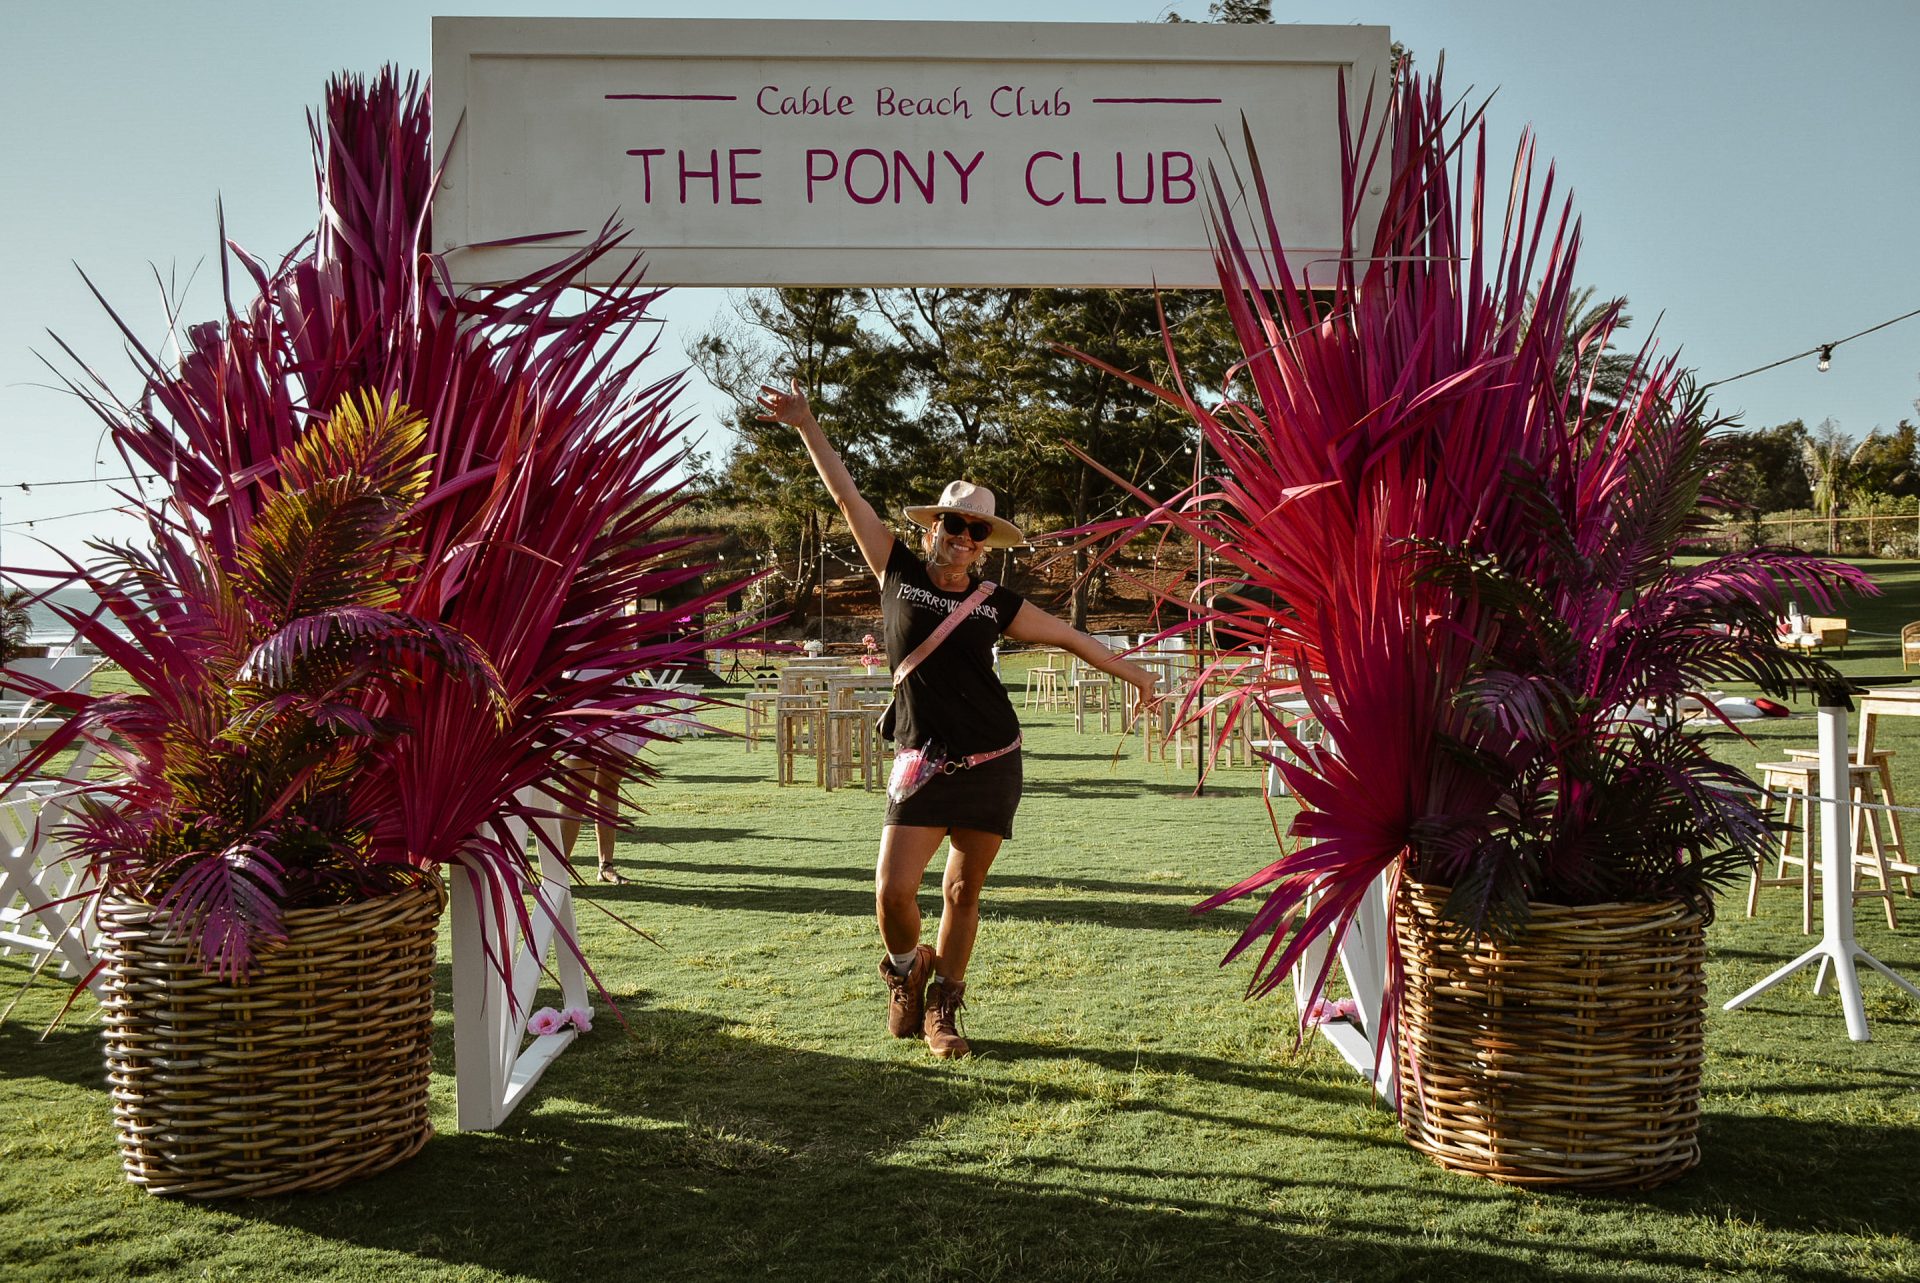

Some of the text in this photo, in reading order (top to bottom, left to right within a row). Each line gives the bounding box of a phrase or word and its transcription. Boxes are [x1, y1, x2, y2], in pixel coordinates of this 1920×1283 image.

[758, 86, 1072, 120] Cable Beach Club
[626, 148, 1196, 206] THE PONY CLUB
[896, 583, 962, 613] TOMORROW
